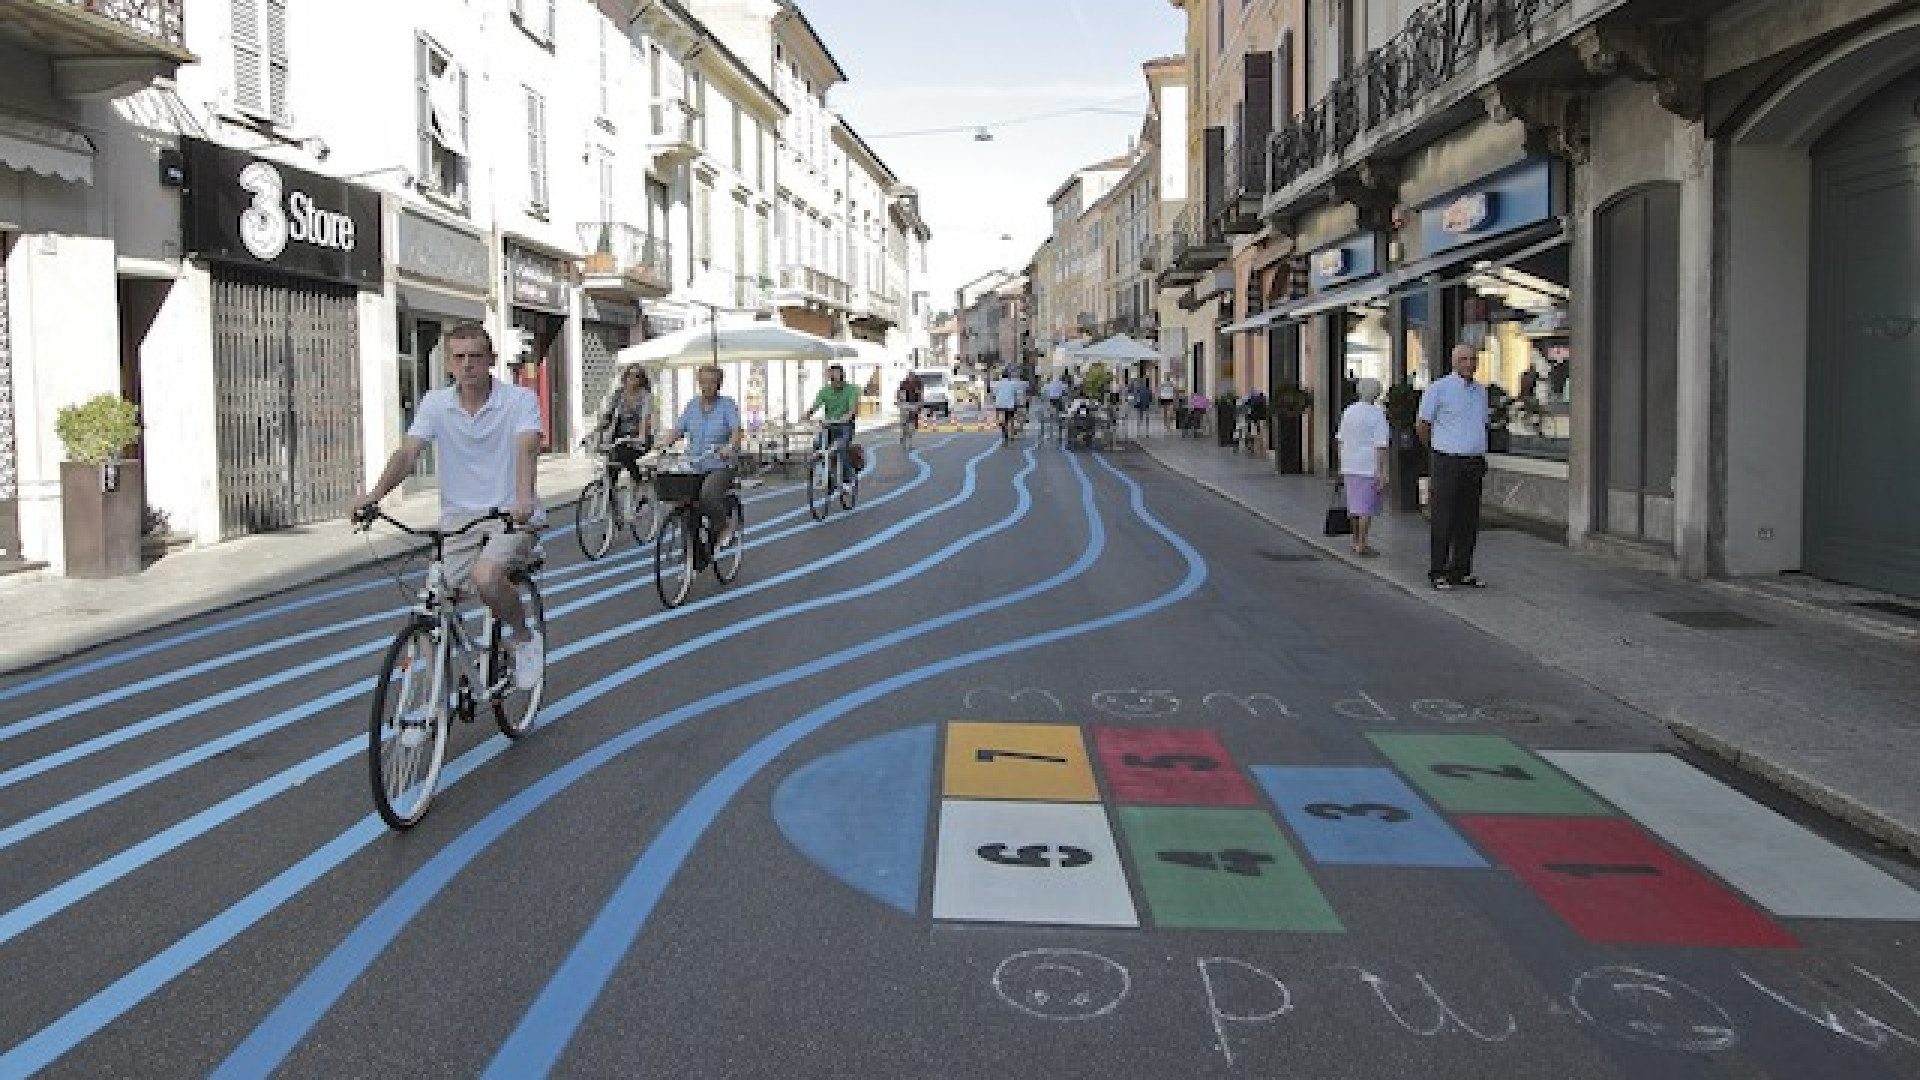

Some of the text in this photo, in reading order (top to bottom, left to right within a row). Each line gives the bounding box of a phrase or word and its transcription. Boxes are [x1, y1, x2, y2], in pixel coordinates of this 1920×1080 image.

[289, 190, 354, 250] Store
[975, 748, 1068, 762] 7
[1123, 753, 1219, 771] 5
[1429, 763, 1536, 780] 2
[1304, 803, 1411, 823] 3
[977, 842, 1094, 868] 6
[1158, 848, 1275, 876] 4
[1541, 863, 1663, 877] 1
